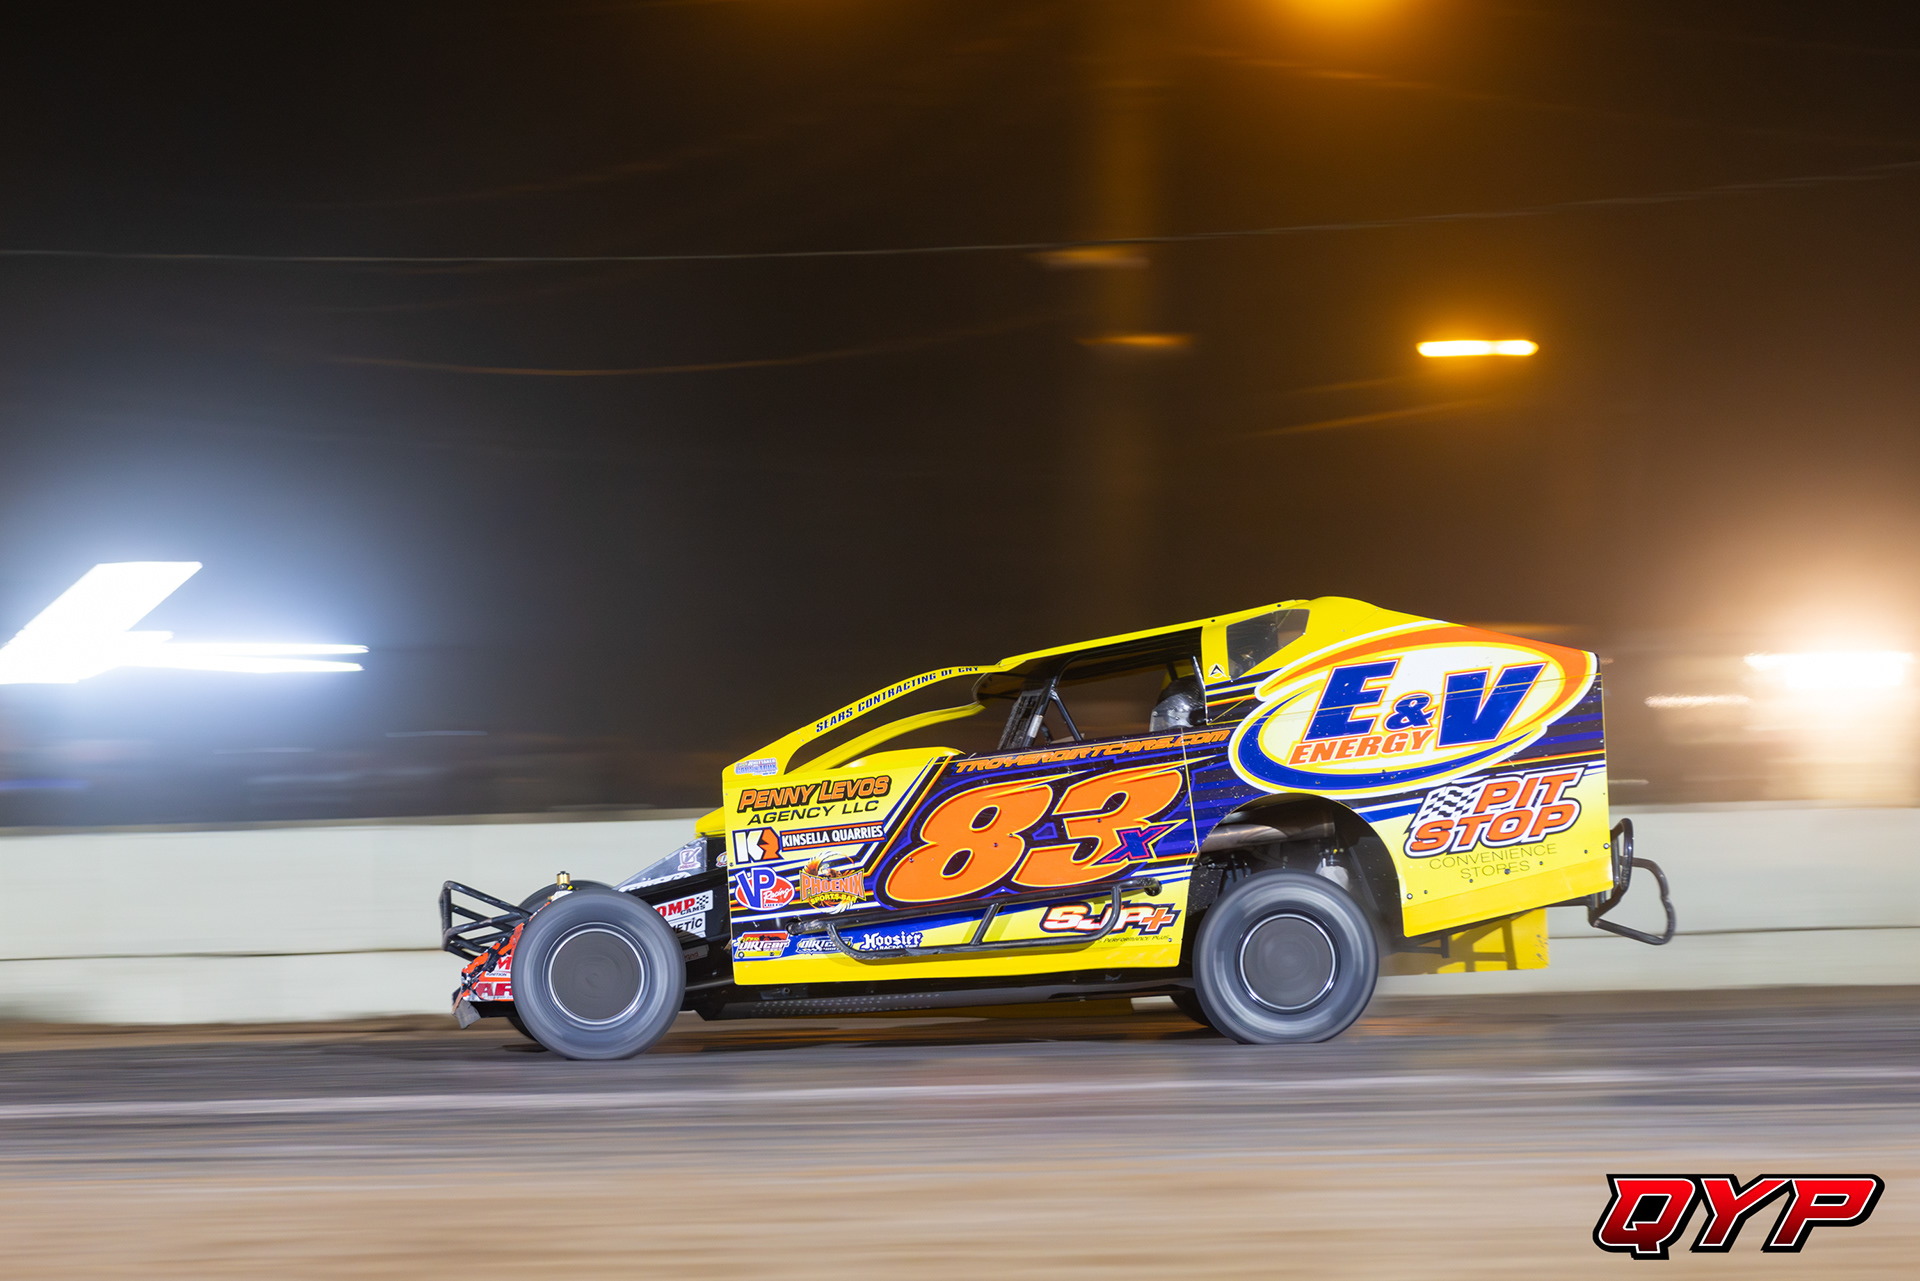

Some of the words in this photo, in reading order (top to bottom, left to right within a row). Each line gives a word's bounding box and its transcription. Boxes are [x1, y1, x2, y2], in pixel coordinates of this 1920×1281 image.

[816, 707, 853, 733] SEARS
[857, 673, 937, 713] CONTRACTING
[941, 668, 953, 677] OF
[955, 729, 1231, 774] TROYERDIRTCARS.COM
[1288, 728, 1435, 766] ENERGY
[738, 784, 819, 812] PENNY
[818, 776, 891, 803] LEVOS
[1474, 772, 1578, 813] PIT
[747, 805, 835, 826] AGENCY
[842, 800, 879, 814] LLC
[1410, 803, 1576, 851] STOP
[782, 829, 831, 848] KINSELLA
[832, 825, 883, 842] QUARRIES
[883, 768, 1184, 904] 83
[1429, 843, 1558, 870] CONVENIENCE
[1460, 860, 1530, 880] STORES
[736, 867, 777, 909] VP
[763, 886, 793, 902] Racing
[801, 871, 865, 901] PHOENIX
[810, 893, 839, 905] SPORTS
[656, 898, 695, 917] OMP
[681, 904, 706, 916] CAMS
[861, 930, 921, 950] Hoosier
